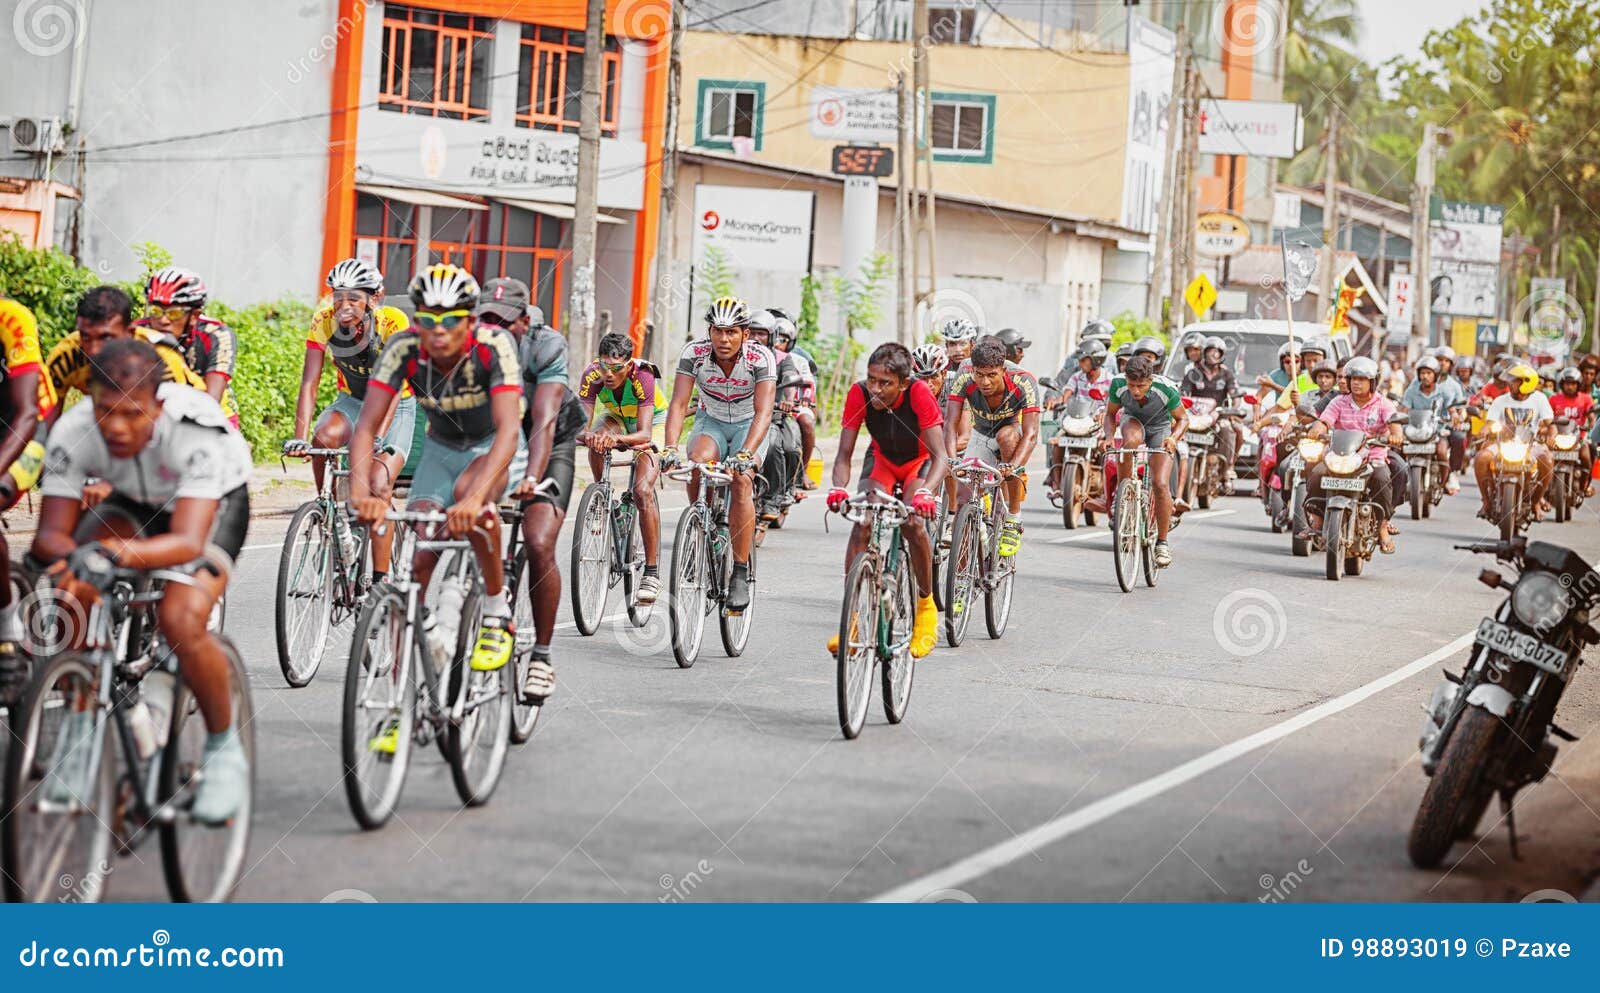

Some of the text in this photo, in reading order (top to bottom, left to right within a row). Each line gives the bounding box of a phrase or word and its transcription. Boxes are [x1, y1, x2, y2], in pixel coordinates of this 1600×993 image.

[838, 147, 884, 173] SET
[724, 219, 802, 236] MoneyGram
[1206, 237, 1233, 247] ATM
